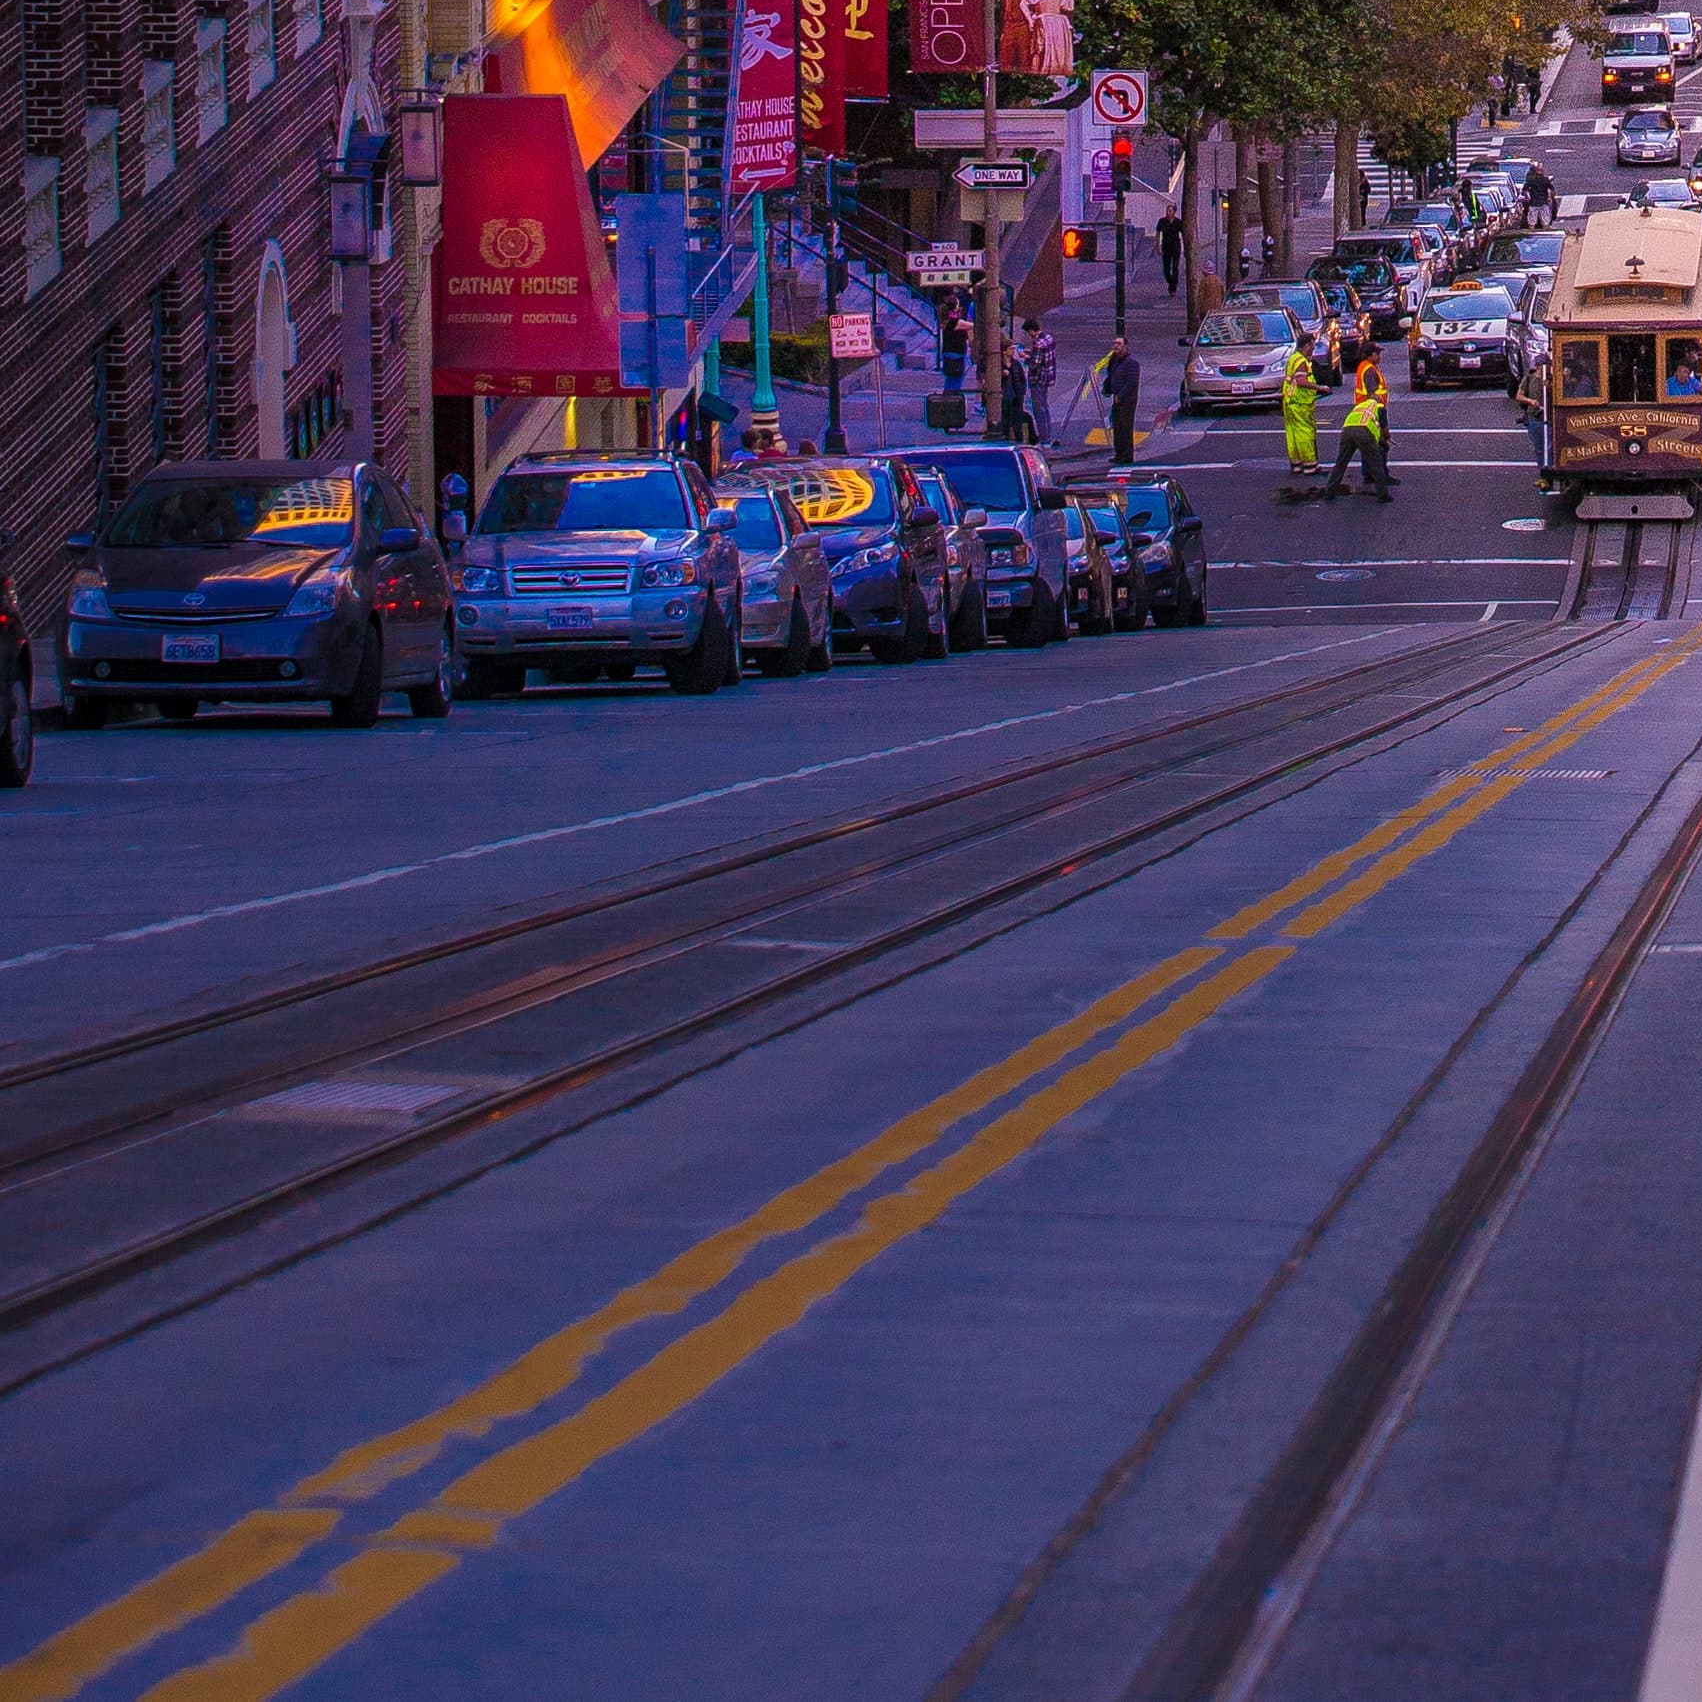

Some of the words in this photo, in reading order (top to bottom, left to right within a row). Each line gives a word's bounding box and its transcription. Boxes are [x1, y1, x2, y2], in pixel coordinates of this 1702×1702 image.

[919, 35, 930, 60] SAN
[736, 99, 763, 120] ATHAY
[765, 96, 795, 116] HOUSE
[735, 119, 795, 142] ESTAURANT
[735, 142, 783, 165] OCKTAILS
[974, 170, 995, 181] ONE
[998, 169, 1021, 181] WAY
[913, 254, 978, 268] GRANT
[448, 277, 514, 295] CATHAY
[521, 276, 578, 295] HOUSE
[448, 313, 514, 324] RESTAURANT
[522, 313, 577, 324] COCKTAILS
[831, 316, 843, 328] NO
[845, 317, 869, 326] PARKING
[1434, 322, 1493, 336] 1327
[1569, 417, 1589, 427] Van
[1589, 414, 1614, 424] Ness
[1646, 412, 1699, 426] California
[1619, 425, 1648, 437] 58
[1566, 449, 1575, 458] &
[1576, 441, 1615, 457] Market
[1657, 440, 1701, 455] Streets
